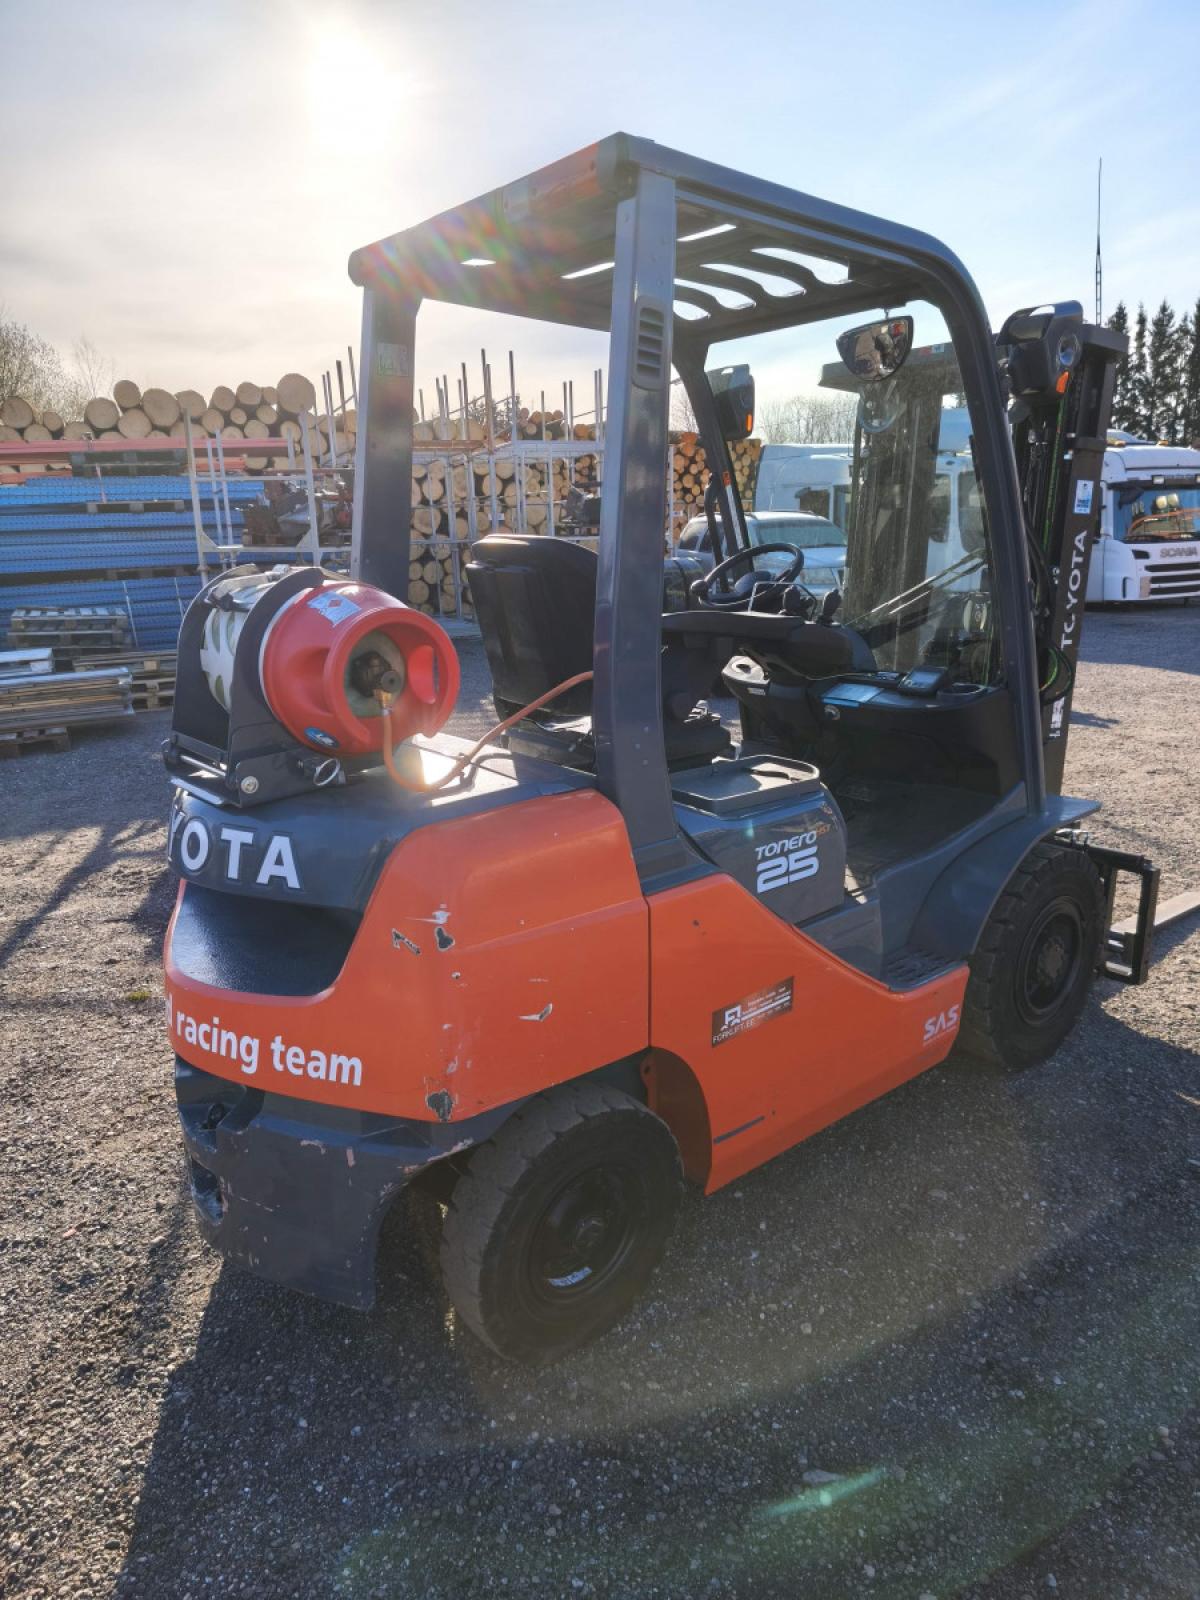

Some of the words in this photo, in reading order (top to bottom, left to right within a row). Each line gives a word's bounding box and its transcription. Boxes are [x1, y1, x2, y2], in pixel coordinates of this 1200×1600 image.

[757, 846, 819, 893] 25
[923, 1004, 960, 1041] SAS
[176, 1010, 260, 1074] racing
[271, 1035, 363, 1086] team
